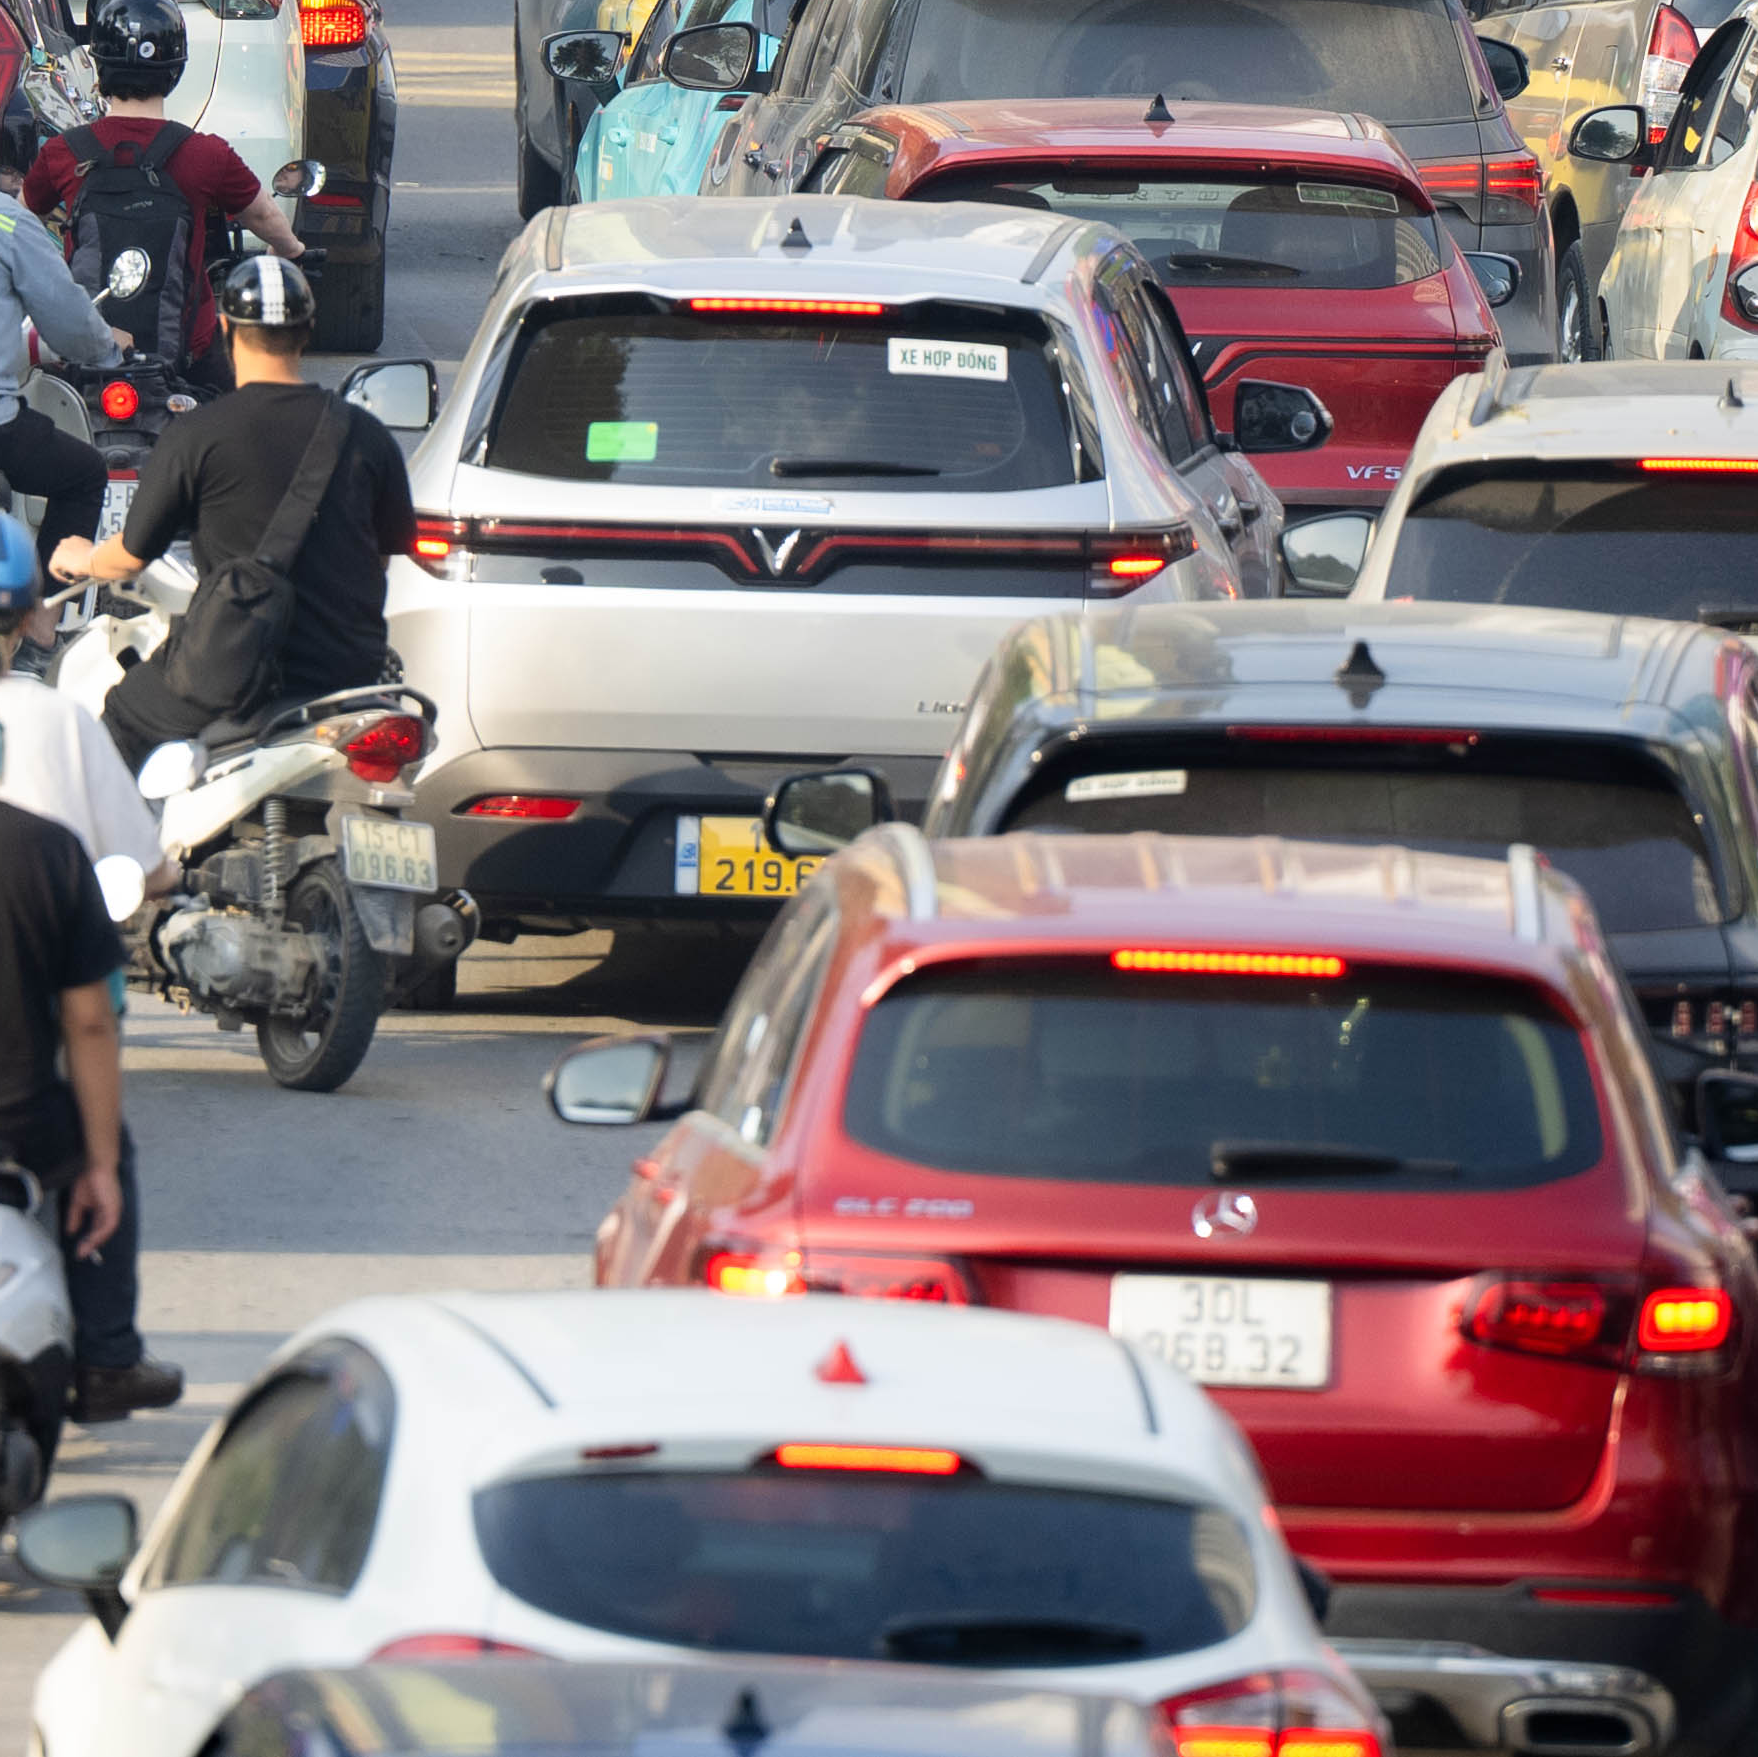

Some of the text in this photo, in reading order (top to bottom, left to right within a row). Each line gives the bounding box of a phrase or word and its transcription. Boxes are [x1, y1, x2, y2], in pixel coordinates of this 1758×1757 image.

[900, 348, 997, 372] XE HỢP ĐỒNG
[360, 821, 422, 853] 15-C1
[351, 851, 433, 886] 096.63
[1180, 1281, 1265, 1326] 30L
